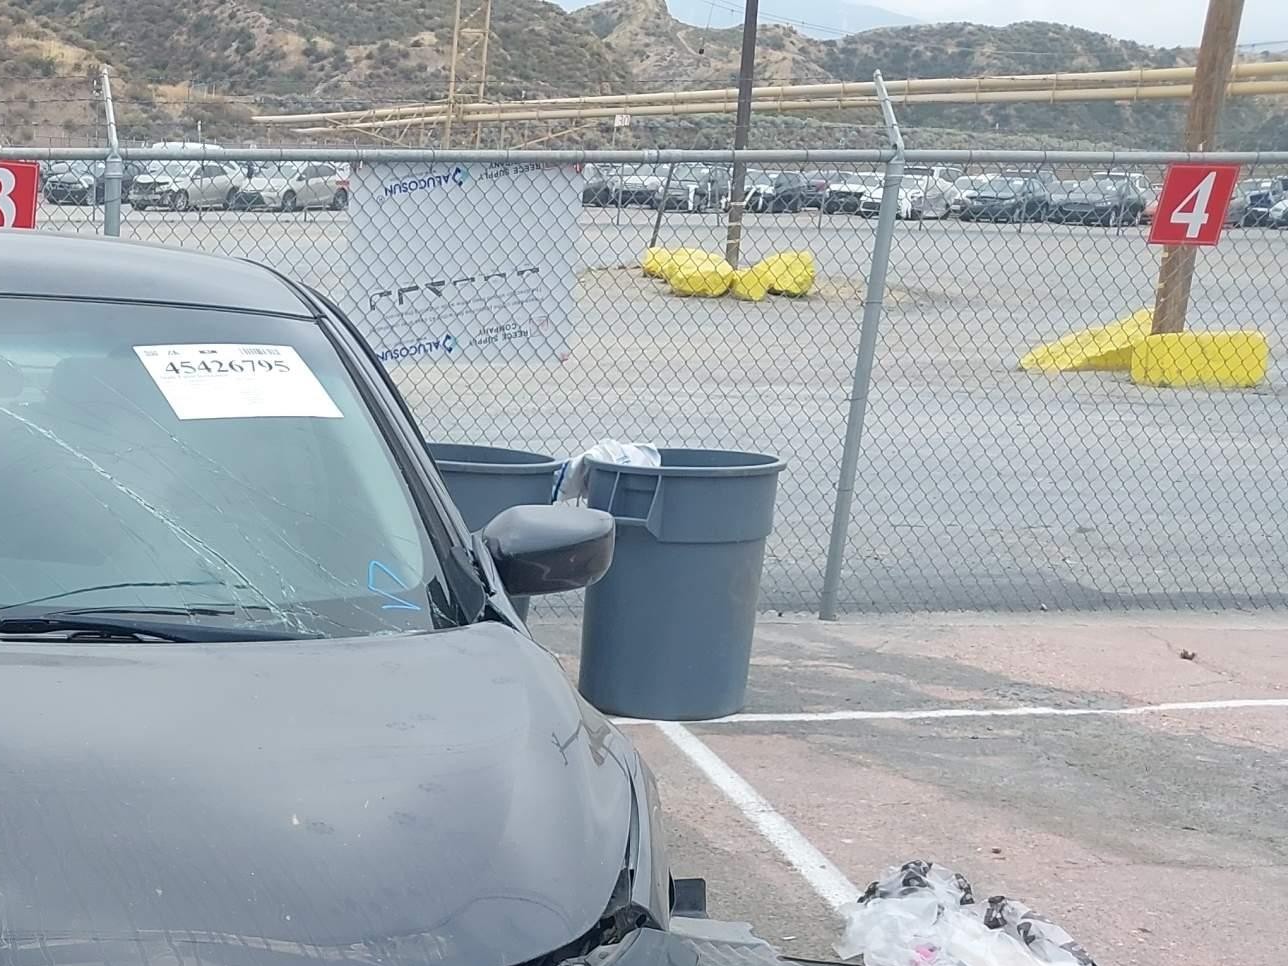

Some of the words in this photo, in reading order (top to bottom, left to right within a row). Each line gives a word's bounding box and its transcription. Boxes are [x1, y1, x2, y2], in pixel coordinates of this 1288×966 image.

[478, 168, 510, 181] SUPPLY
[513, 163, 541, 175] REECE
[1170, 171, 1216, 238] 4
[165, 359, 291, 375] 45426795
